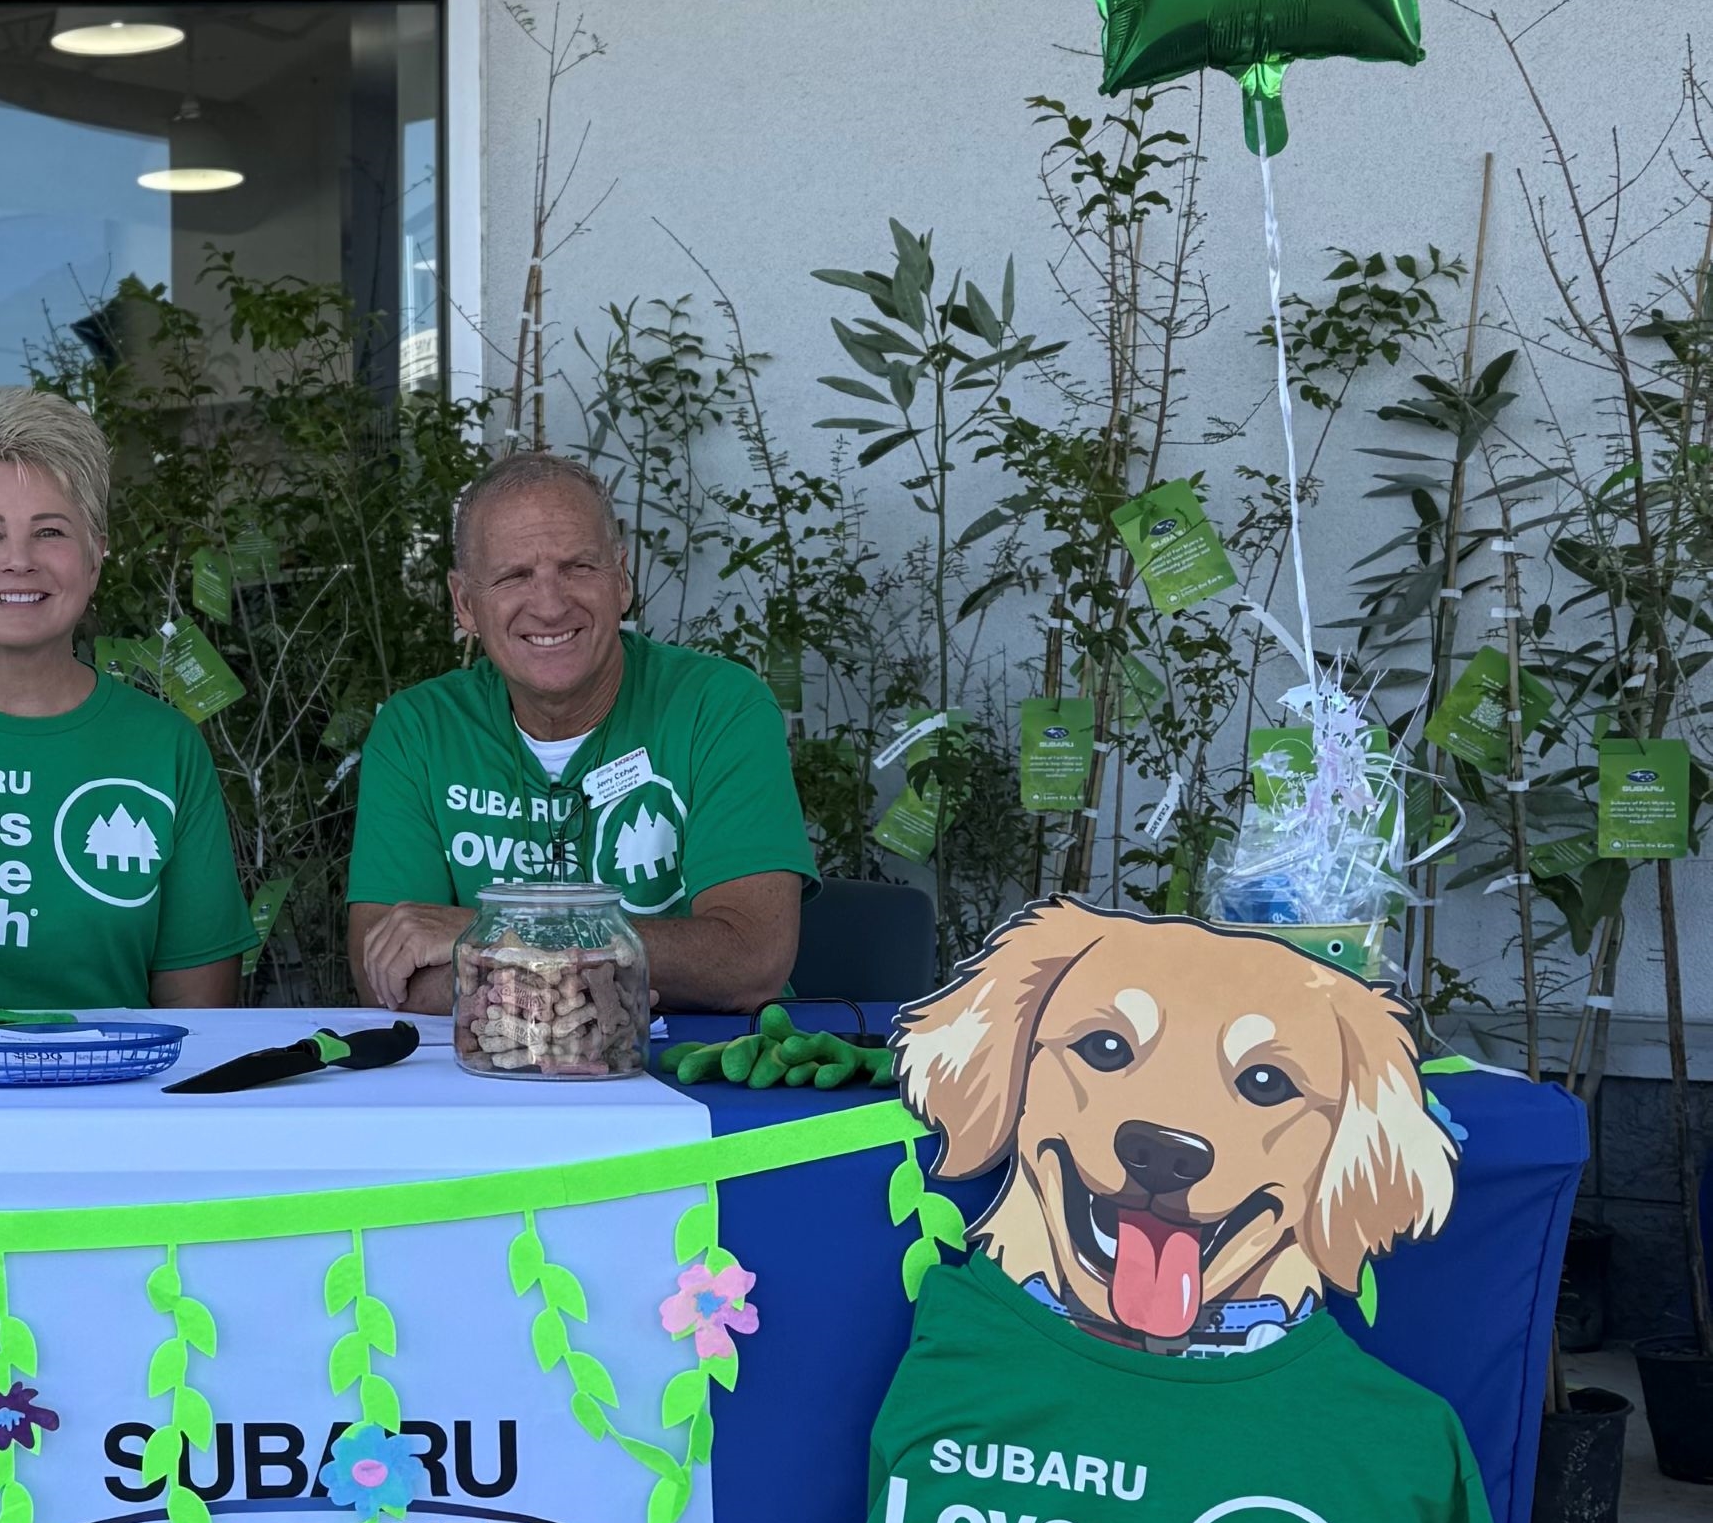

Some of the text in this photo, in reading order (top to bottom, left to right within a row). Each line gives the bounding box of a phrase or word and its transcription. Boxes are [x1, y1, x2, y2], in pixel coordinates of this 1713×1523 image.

[446, 784, 573, 823] SUBARU
[445, 831, 578, 876] oves
[929, 1438, 1148, 1502] SUBARU
